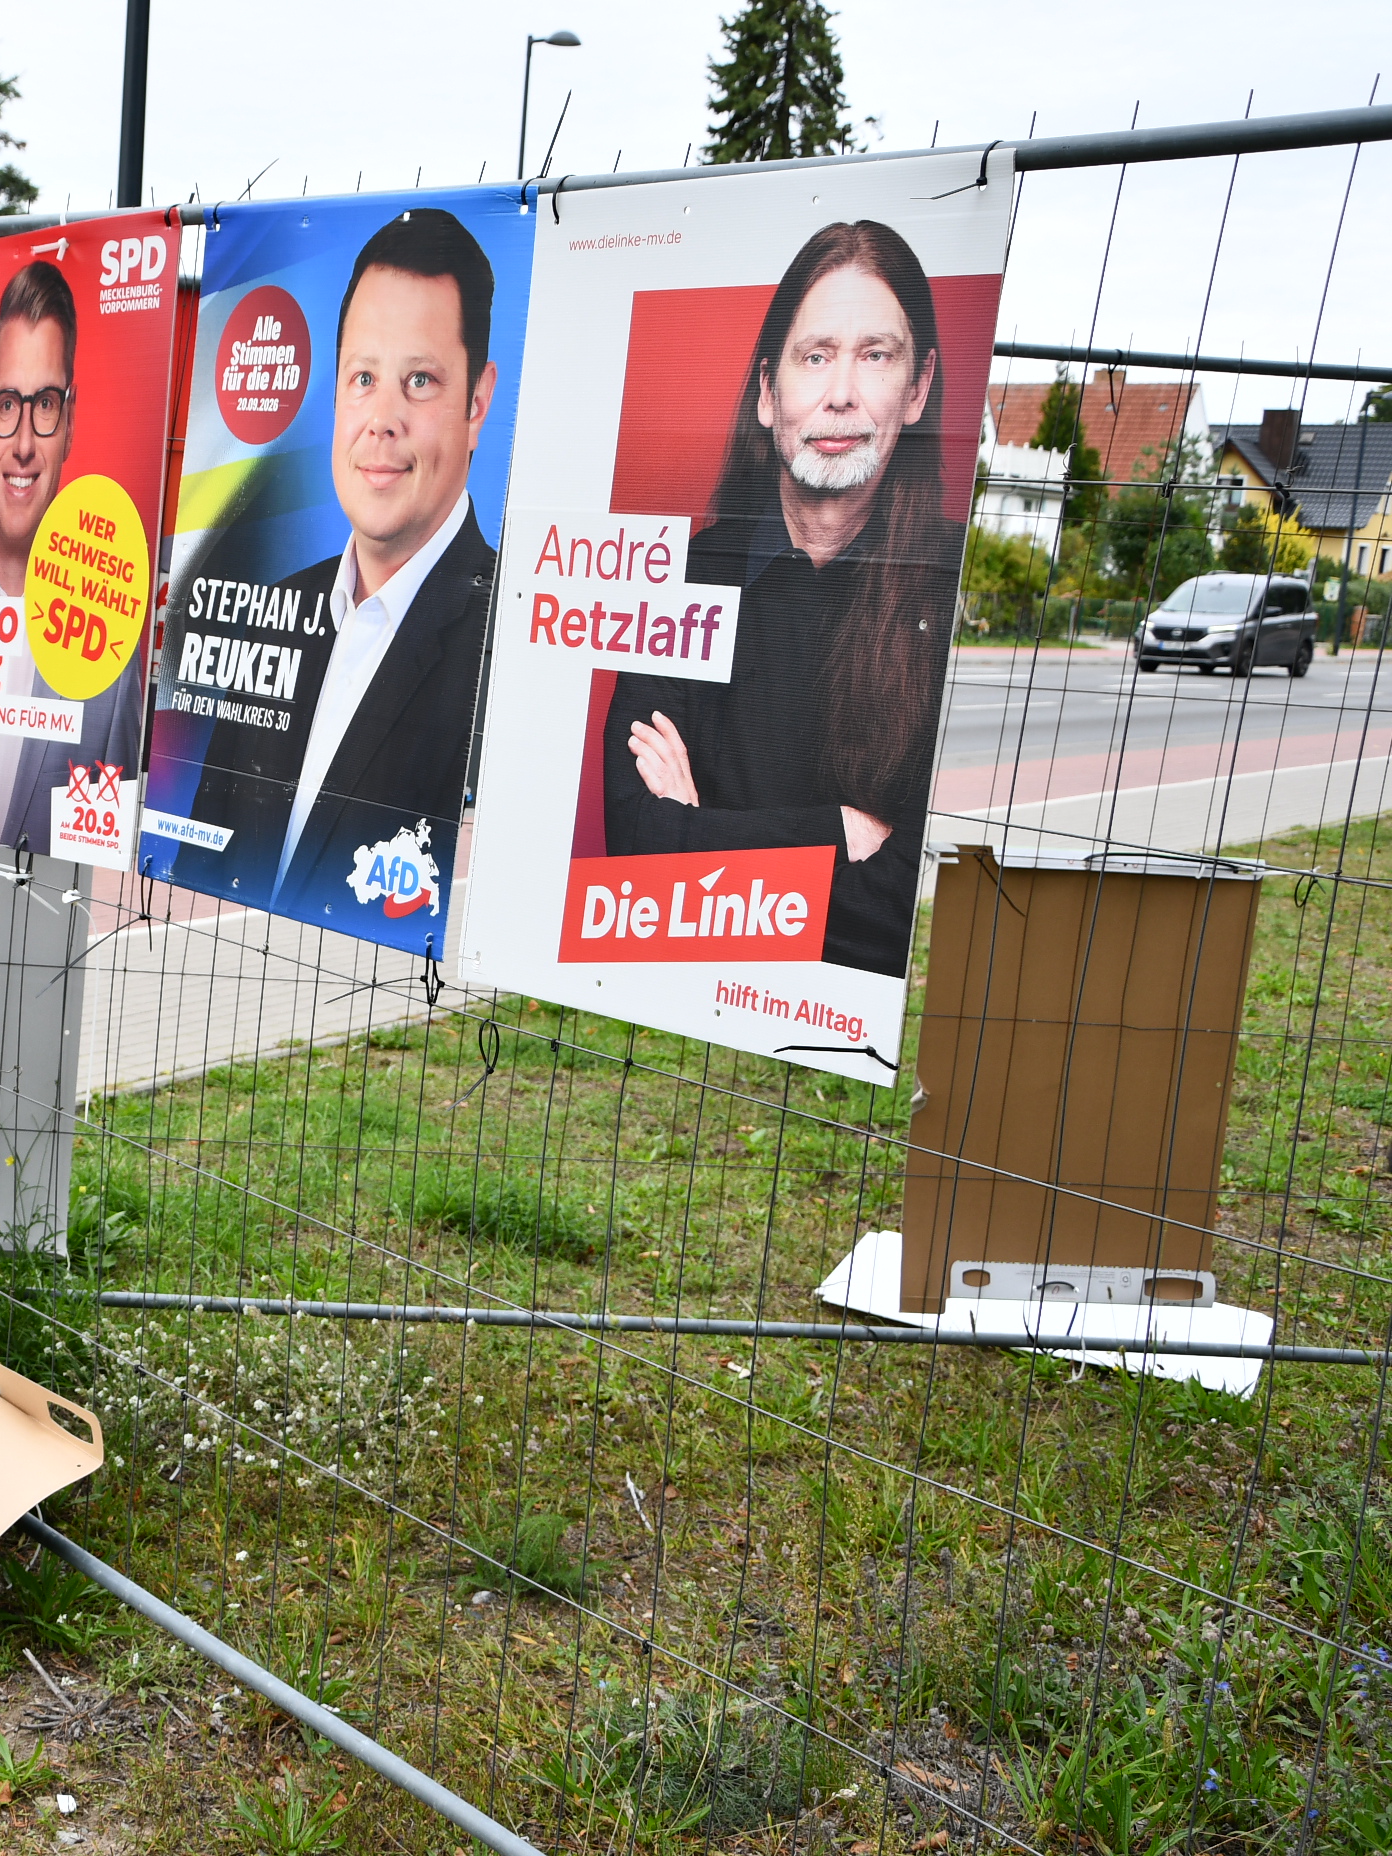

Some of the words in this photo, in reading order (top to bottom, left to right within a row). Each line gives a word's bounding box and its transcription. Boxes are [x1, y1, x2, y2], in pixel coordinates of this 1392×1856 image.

[569, 230, 682, 251] www.dielinke-mv.de
[99, 235, 167, 287] SPD
[99, 283, 163, 302] MECKLENBURG-
[99, 297, 160, 315] VORPOMMERN
[252, 315, 282, 341] Alle
[230, 340, 296, 366] Stimmen
[221, 365, 245, 391] für
[246, 365, 270, 391] die
[271, 364, 301, 391] AfD
[236, 397, 280, 412] 20.09.2026
[78, 509, 116, 543] WER
[48, 531, 135, 584] SCHWESIG
[534, 524, 672, 584] André
[34, 556, 75, 597] WILL,
[81, 575, 142, 620] WÄHLT
[188, 576, 302, 633] STEPHAN
[303, 592, 327, 637] J.
[529, 592, 723, 662] Retzlaff
[177, 632, 303, 700] REUKEN
[19, 706, 47, 729] FÜR
[50, 713, 75, 732] MV.
[171, 688, 192, 713] FÜR
[193, 696, 215, 718] DEN
[216, 699, 275, 729] WAHLKREIS
[275, 710, 291, 732] 30
[60, 821, 71, 829] AM
[72, 806, 120, 838] 20.9.
[156, 818, 224, 847] www.afd-mv.de
[59, 831, 77, 842] BEIDE
[78, 835, 106, 847] STIMMEN
[106, 839, 119, 849] SPD
[365, 854, 420, 896] AfD
[580, 880, 660, 939] Die
[667, 865, 809, 938] Linke
[715, 980, 759, 1012] hilft
[762, 990, 790, 1019] im
[793, 999, 869, 1043] Alltag.
